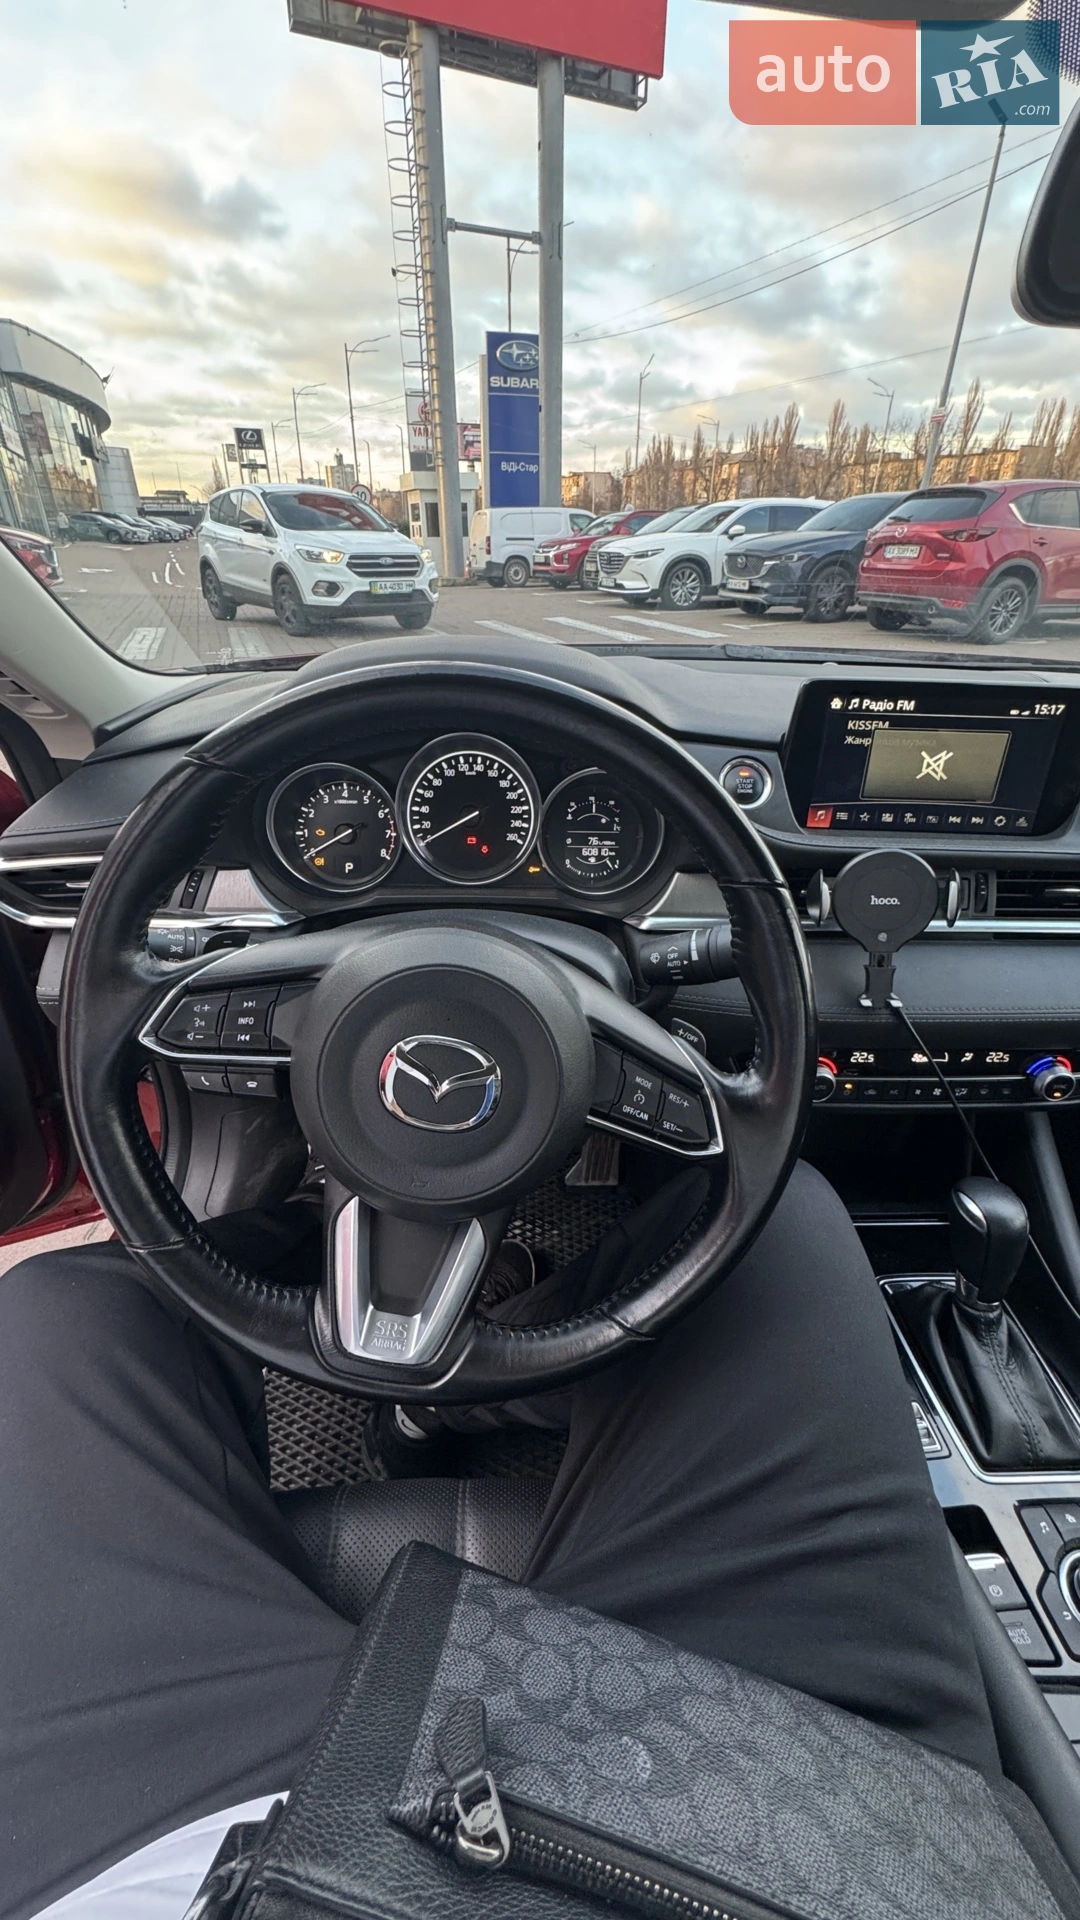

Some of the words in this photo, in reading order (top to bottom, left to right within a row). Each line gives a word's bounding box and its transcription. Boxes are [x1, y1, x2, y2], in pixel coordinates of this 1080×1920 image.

[489, 376, 539, 389] SUBAR
[862, 699, 894, 712] Радіо
[896, 700, 915, 711] FM
[1034, 704, 1066, 715] 15:17
[847, 720, 890, 730] KISSFM
[473, 764, 484, 772] 140
[487, 769, 498, 777] 160
[432, 778, 442, 786] 80
[499, 780, 510, 788] 180
[342, 789, 348, 798] 4
[424, 790, 434, 798] 60
[506, 792, 518, 800] 200
[323, 795, 329, 803] 3
[363, 796, 370, 804] 5
[420, 805, 430, 813] 40
[510, 806, 522, 814] 220
[308, 809, 315, 818] 2
[378, 809, 385, 818] 6
[421, 821, 431, 829] 20
[510, 820, 522, 828] 240
[304, 829, 308, 838] 1
[385, 830, 391, 838] 7
[506, 833, 518, 841] 260
[380, 849, 387, 857] 8
[345, 862, 354, 873] P
[870, 895, 900, 905] hoco.
[667, 952, 679, 960] OFF
[667, 960, 681, 968] AUTO
[237, 1017, 255, 1025] INFO
[634, 1075, 653, 1090] MODE
[622, 1104, 649, 1121] OFF/CAN
[374, 1319, 409, 1339] SRS
[371, 1337, 407, 1351] AIRBAG
[1007, 1628, 1028, 1637] AUTO
[1011, 1636, 1032, 1645] HOLD
